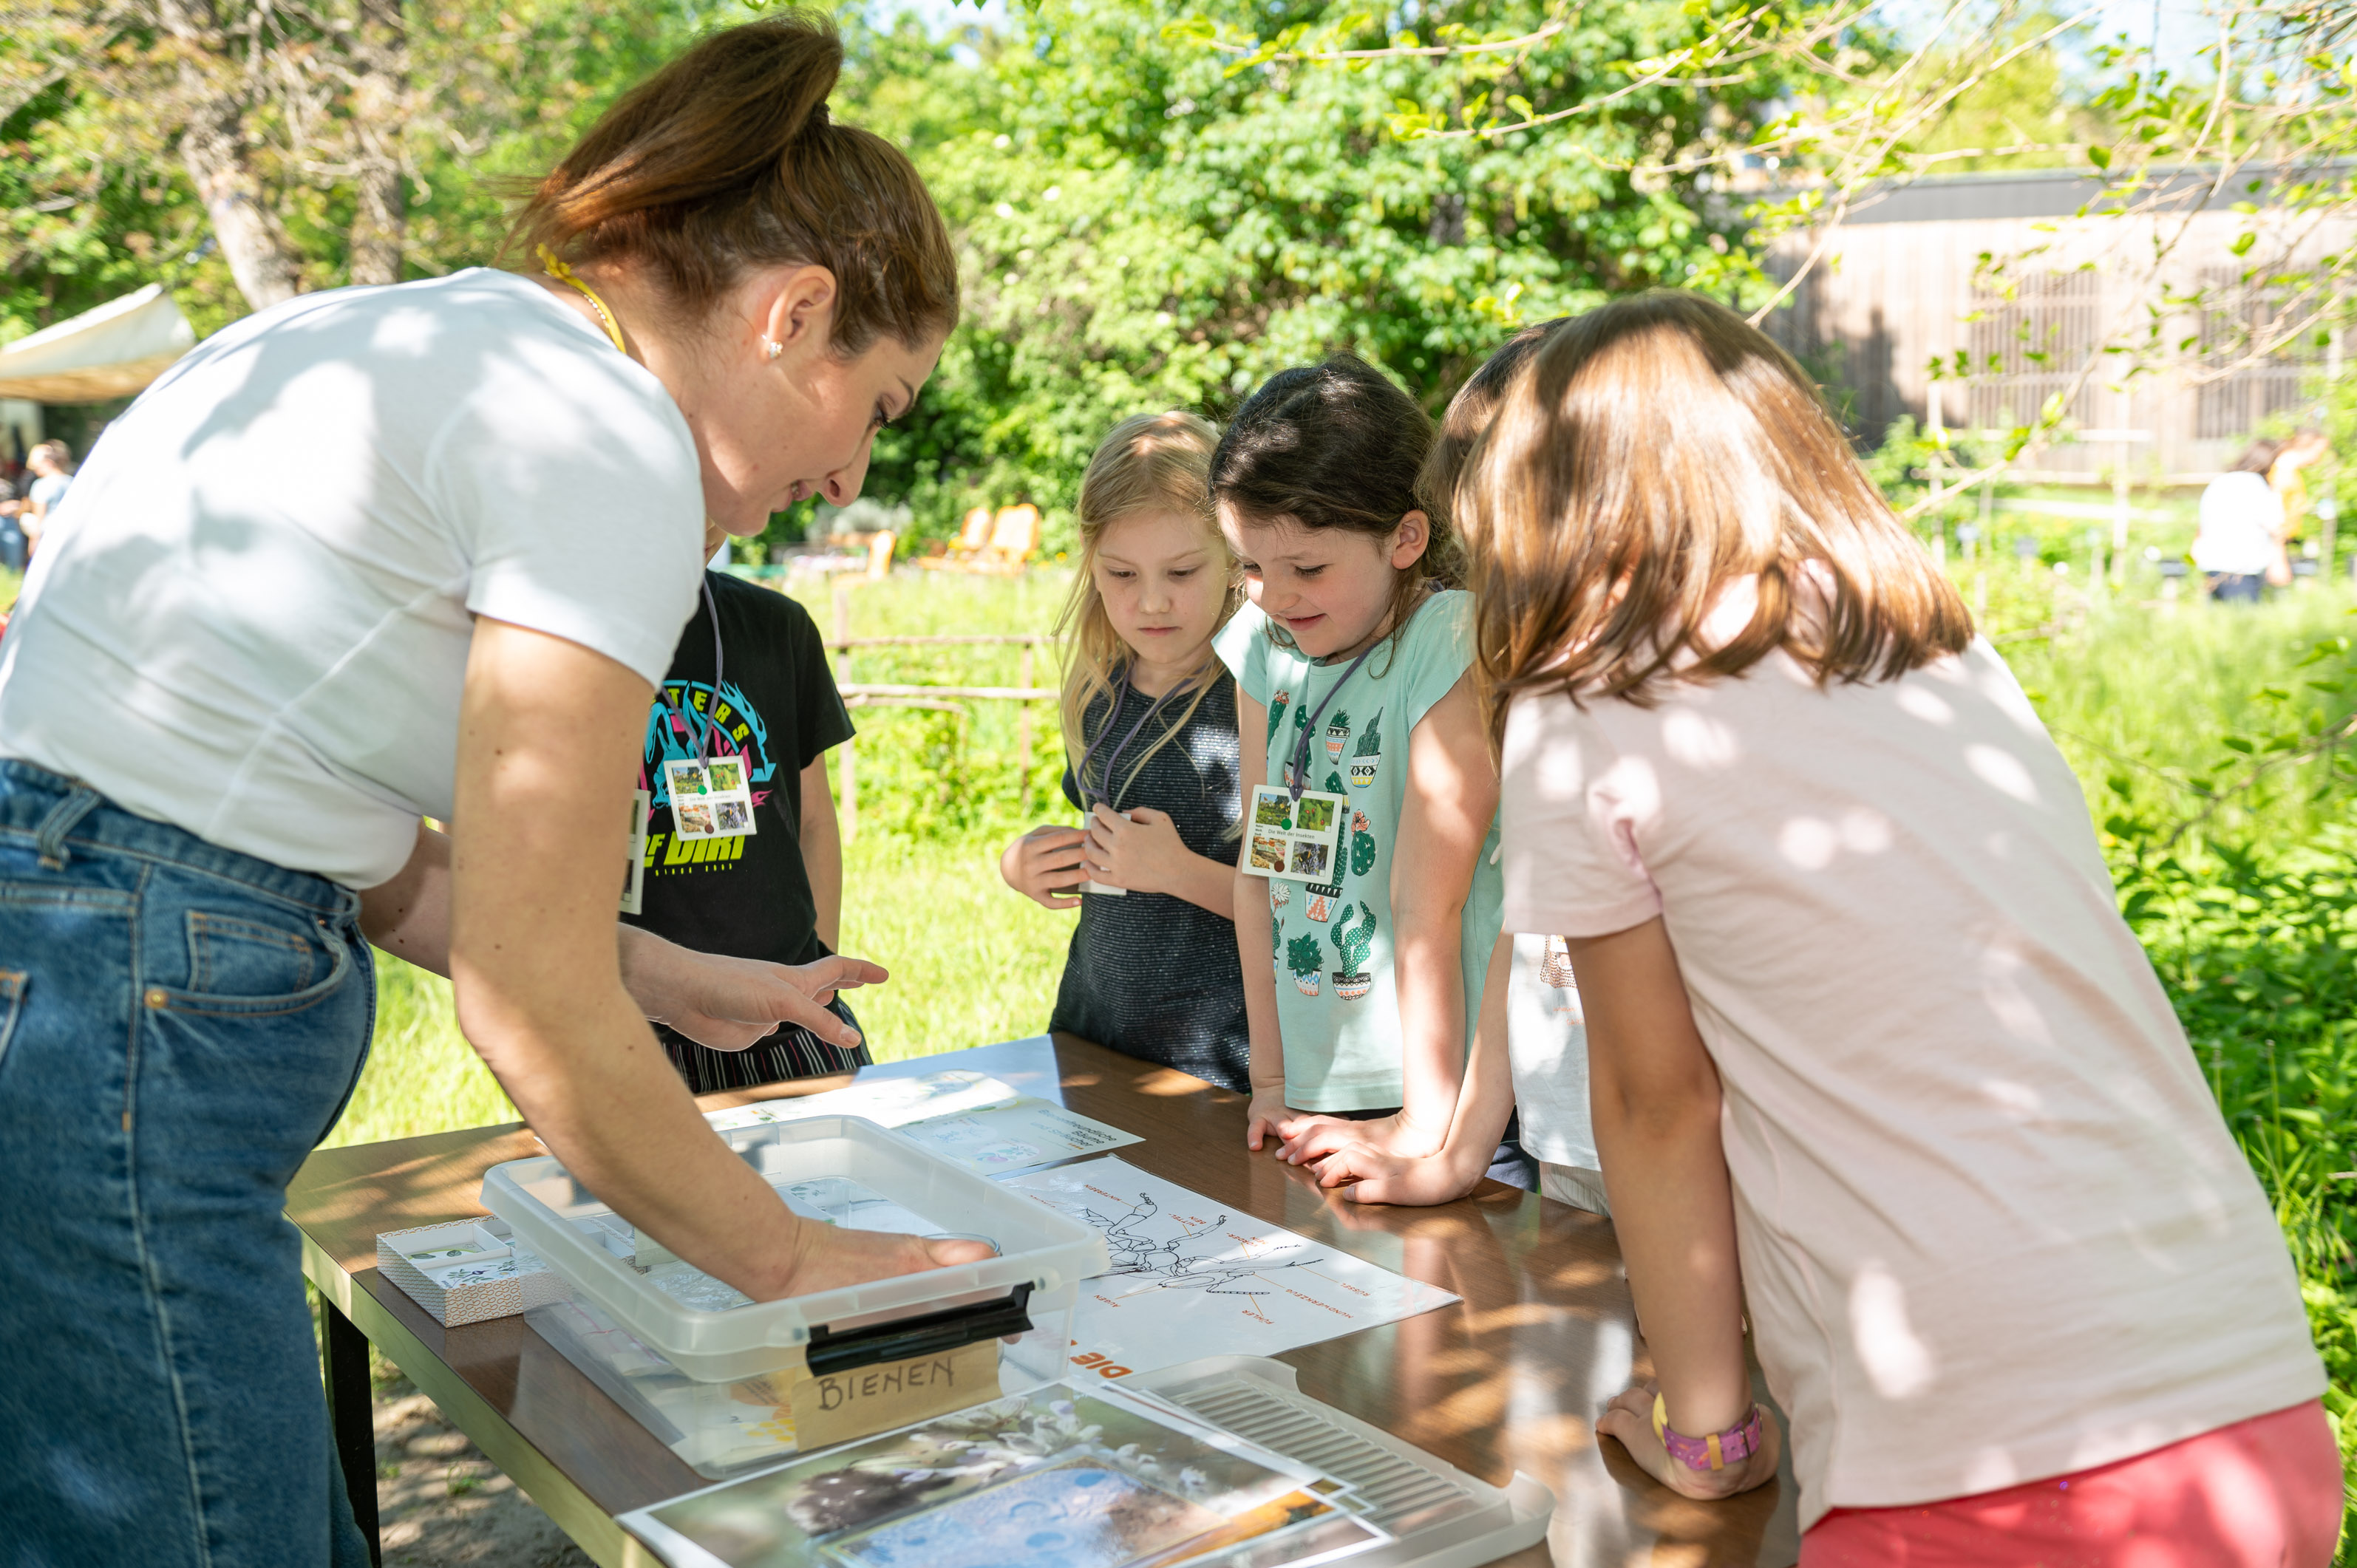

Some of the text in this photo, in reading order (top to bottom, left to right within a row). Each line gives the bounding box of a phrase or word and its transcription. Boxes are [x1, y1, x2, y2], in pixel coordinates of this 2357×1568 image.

[652, 687, 749, 743] TERS
[1168, 1213, 1197, 1227] MITTEL-
[1188, 1216, 1207, 1224] BEIN
[1340, 1282, 1371, 1297] RÜSSEL
[1094, 1295, 1121, 1308] AUGEN
[1285, 1289, 1354, 1319] MUNDWERKZEUG
[1242, 1309, 1275, 1325] FÜHLER
[1069, 1351, 1133, 1380] DIE
[818, 1356, 955, 1411] BIENEN
